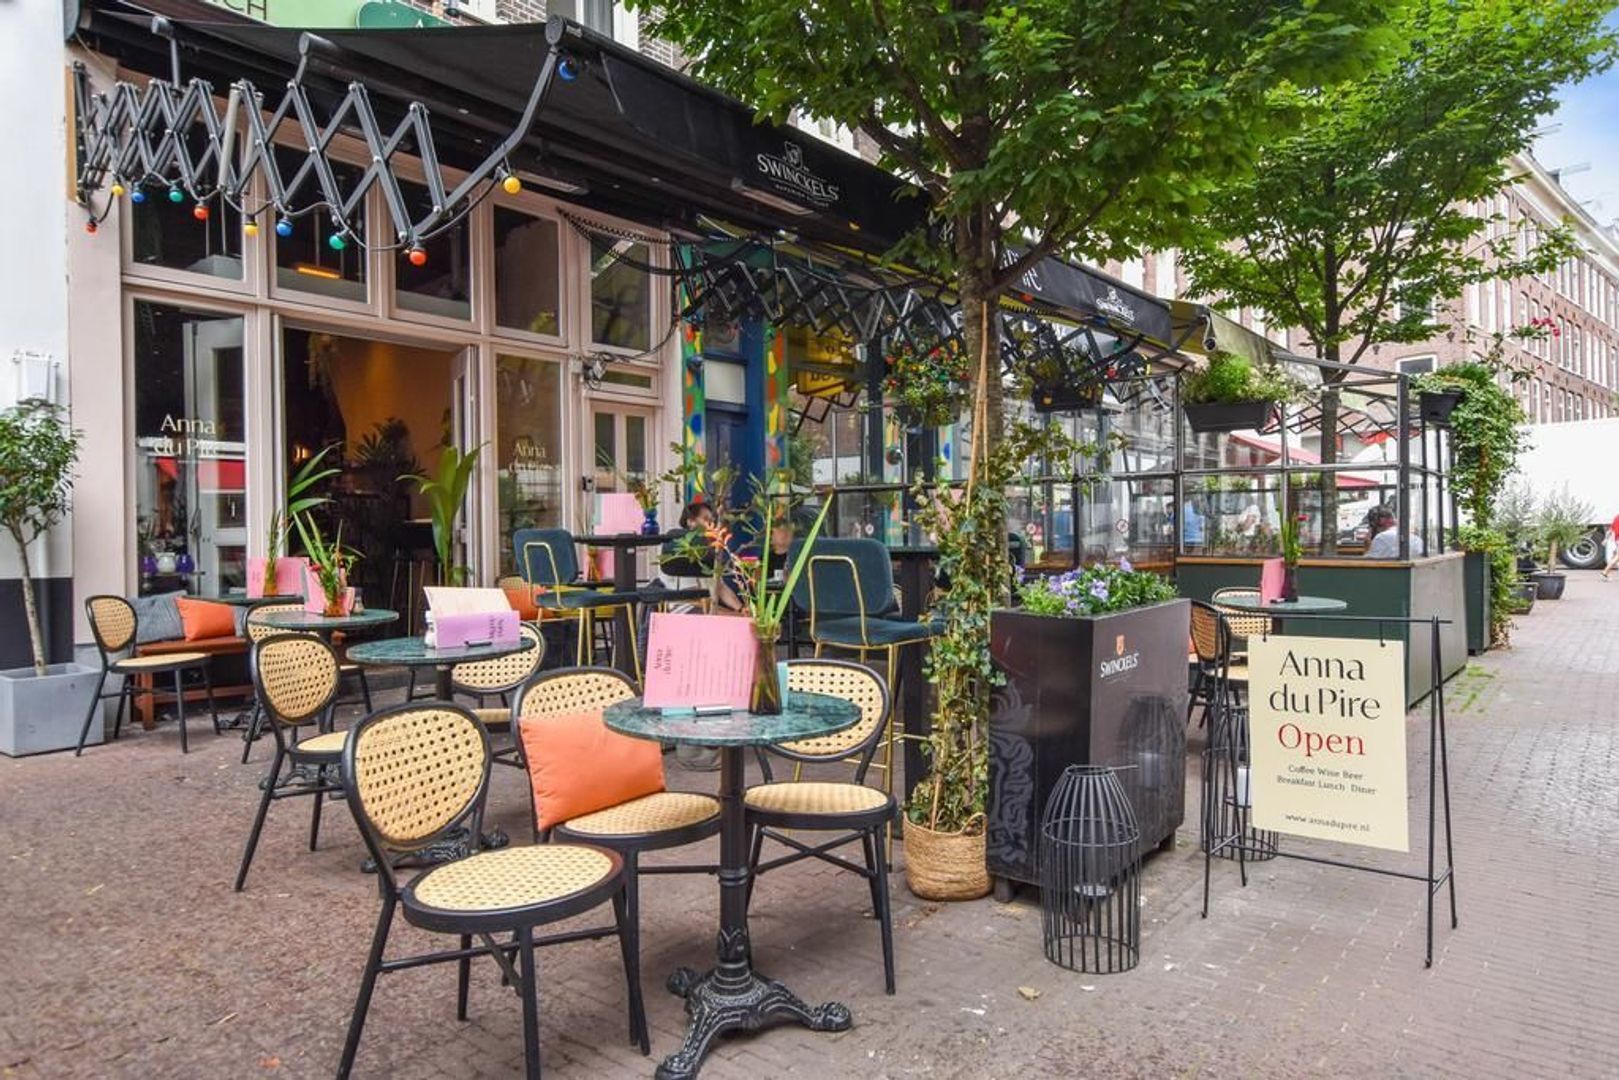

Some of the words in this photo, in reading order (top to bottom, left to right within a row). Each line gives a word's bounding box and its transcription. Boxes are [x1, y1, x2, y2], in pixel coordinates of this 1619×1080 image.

[160, 413, 216, 434] Anna
[154, 435, 182, 456] du
[1279, 650, 1365, 681] Anna
[1269, 683, 1310, 713] du
[1318, 688, 1380, 720] Pire
[1278, 723, 1366, 757] Open
[1288, 764, 1315, 774] Coffee
[1317, 767, 1340, 777] Wine
[1342, 770, 1363, 780] Beer
[1277, 775, 1315, 787] Breakfast
[1318, 781, 1345, 791] Lunch
[1351, 784, 1376, 795] Diner
